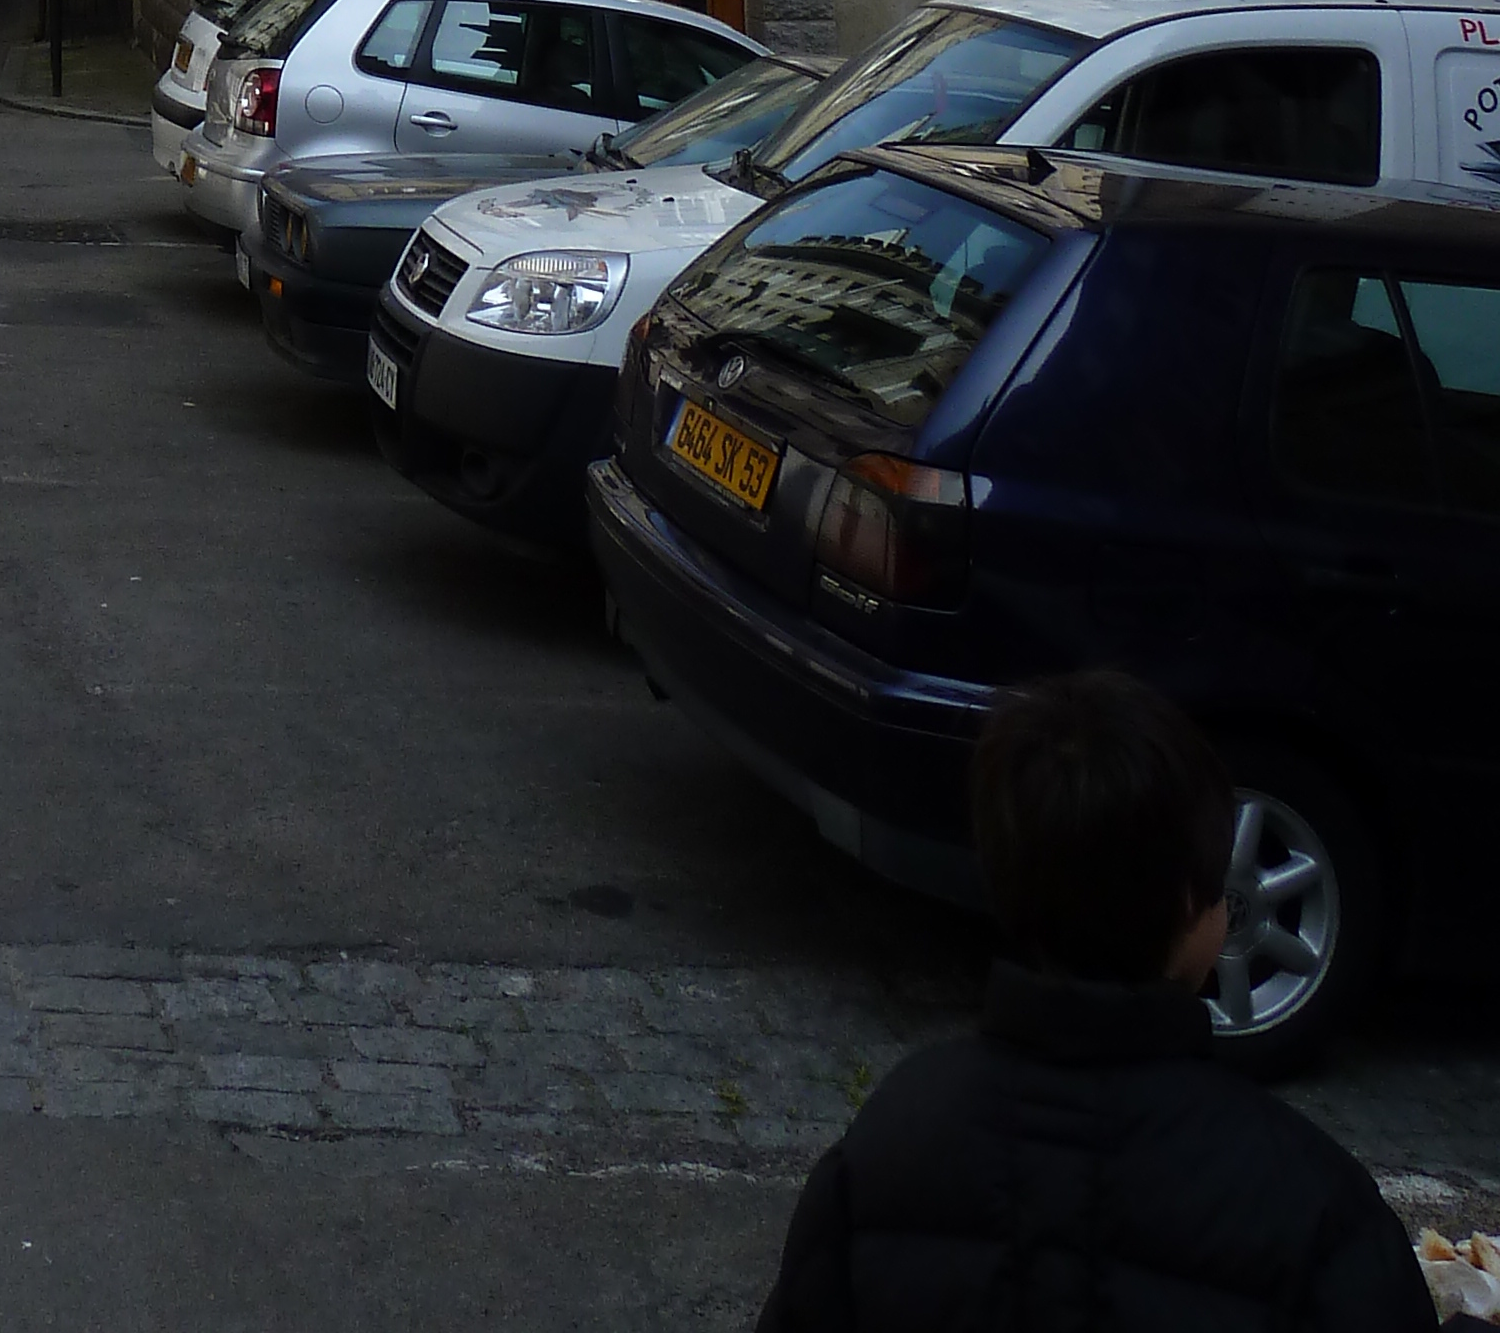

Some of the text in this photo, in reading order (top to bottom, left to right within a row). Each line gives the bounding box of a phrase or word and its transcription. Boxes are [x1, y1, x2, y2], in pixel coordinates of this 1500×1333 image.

[677, 407, 719, 467] 6464
[714, 432, 744, 483] SK
[738, 446, 769, 499] 53
